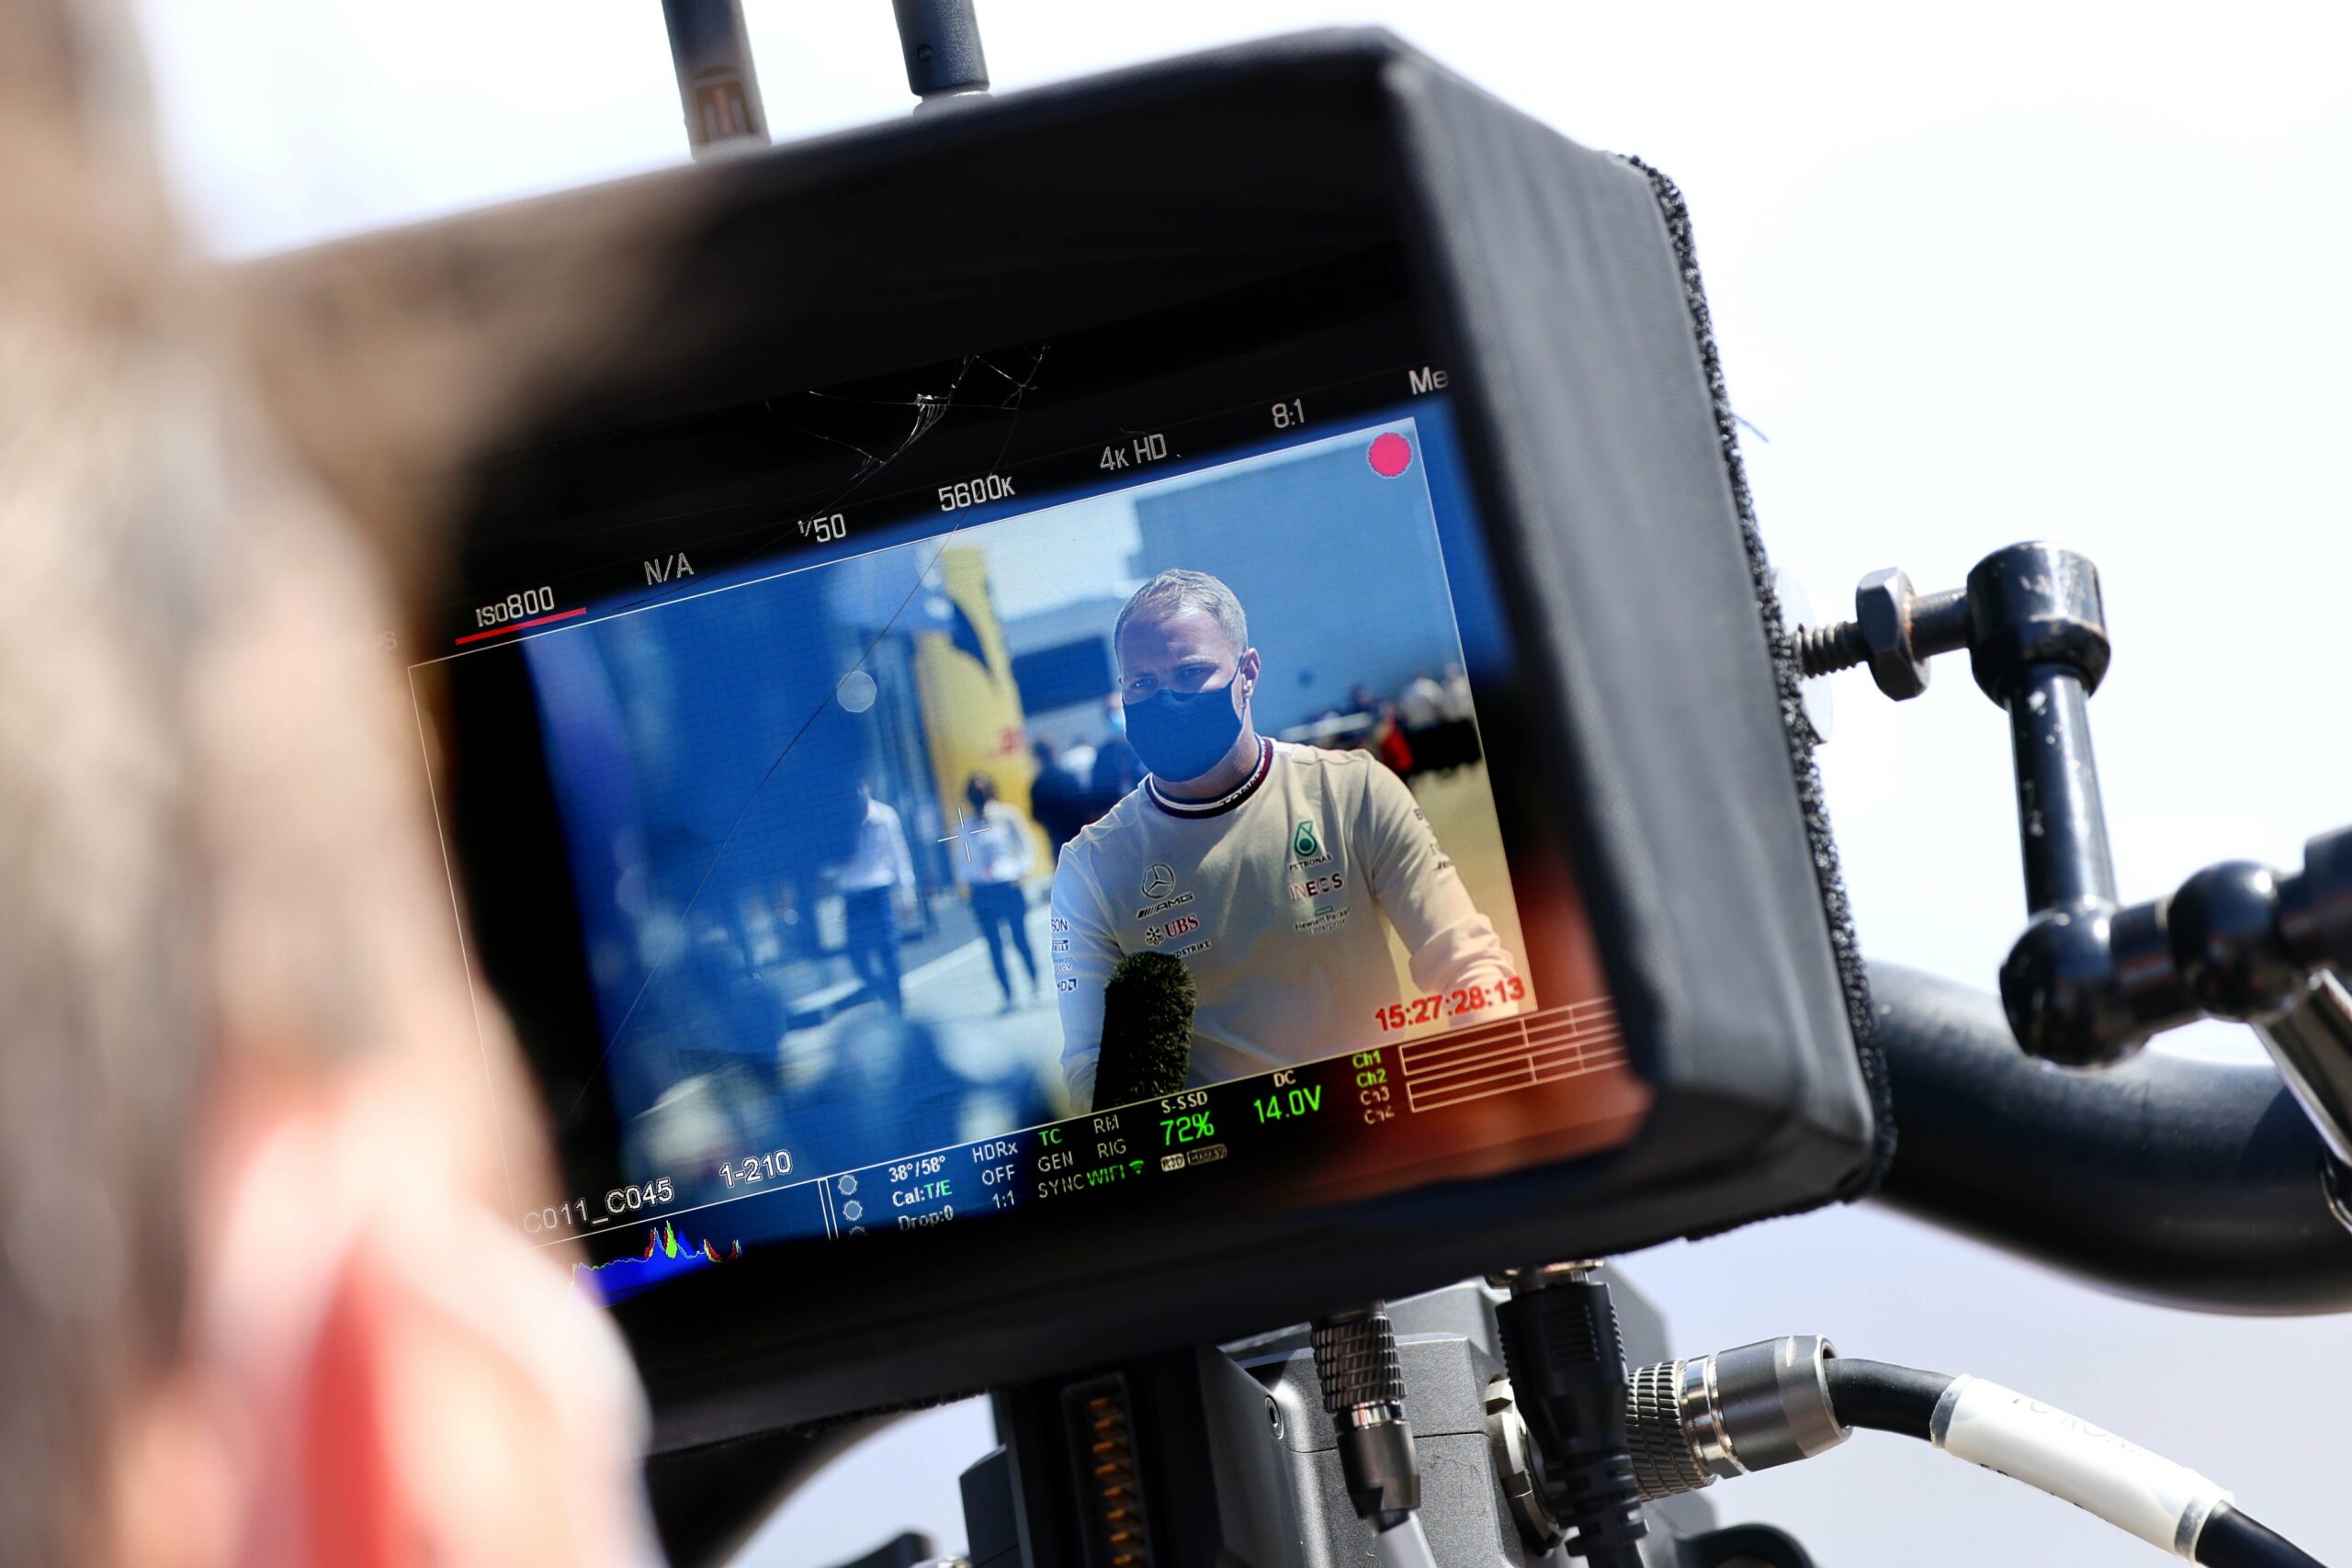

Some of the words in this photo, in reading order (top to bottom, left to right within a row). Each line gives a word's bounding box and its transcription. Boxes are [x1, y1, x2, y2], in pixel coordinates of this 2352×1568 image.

[1272, 399, 1306, 429] 8:1
[1132, 434, 1168, 465] HD
[644, 552, 695, 585] N/A
[1290, 873, 1343, 901] INEOS
[1164, 914, 1199, 938] UBS
[1375, 976, 1526, 1032] 15:27:28:13
[1352, 1050, 1382, 1069] Ch1
[1273, 1069, 1296, 1088] DC
[1356, 1068, 1387, 1088] Ch2
[1161, 1091, 1208, 1114] S-SSD
[1253, 1085, 1322, 1123] 14.0V
[1038, 1128, 1063, 1146] TC
[1160, 1111, 1215, 1145] 72%
[1097, 1139, 1126, 1158] RIG
[720, 1149, 792, 1188] 1-210
[888, 1156, 946, 1183] 38°/58°
[1038, 1151, 1074, 1172] GEN
[982, 1164, 1015, 1185] OFF
[1038, 1174, 1085, 1198] SYNC
[1087, 1164, 1125, 1186] WIFI
[892, 1179, 953, 1207] Cal:T/E
[992, 1190, 1014, 1209] 1:1
[524, 1178, 674, 1234] C011_C045
[898, 1204, 955, 1232] Drop:0
